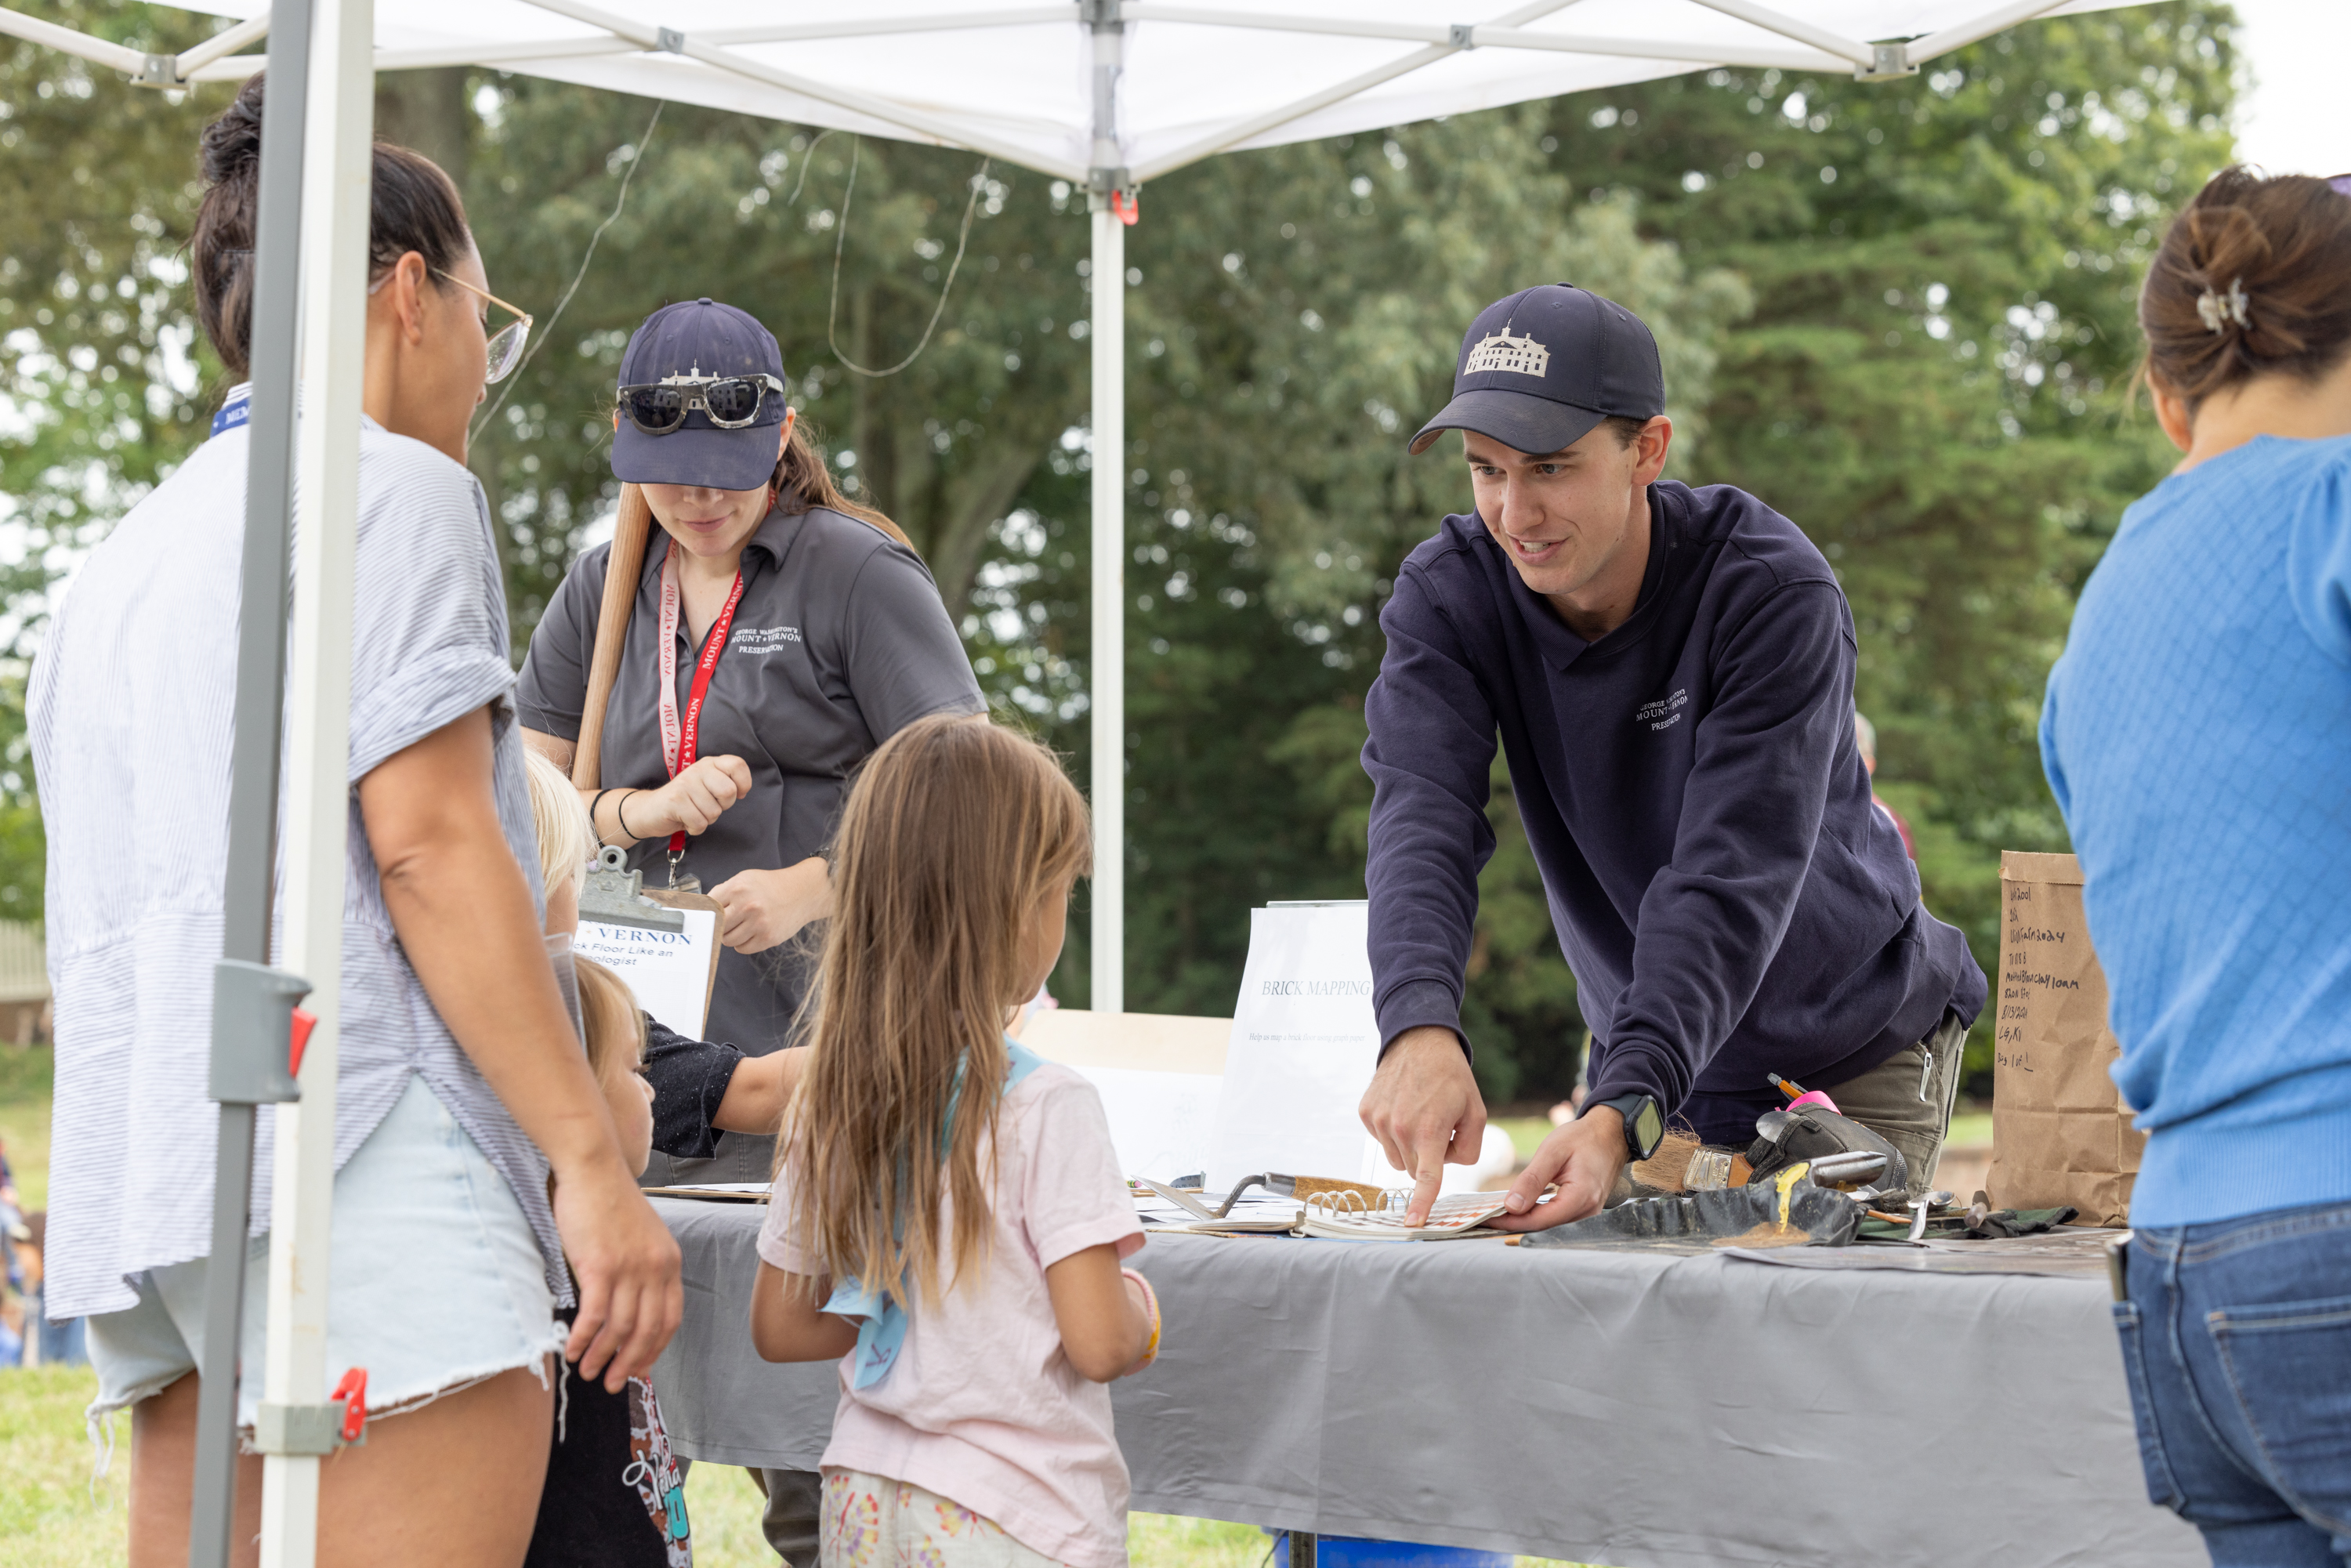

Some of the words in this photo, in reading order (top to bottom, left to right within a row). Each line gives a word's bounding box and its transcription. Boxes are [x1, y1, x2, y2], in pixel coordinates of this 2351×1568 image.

[730, 635, 762, 644] MOUNT
[767, 632, 801, 643] VERNON
[702, 626, 725, 669] MOUNT
[1636, 707, 1668, 722] MOUNT
[684, 697, 700, 749] VERNON
[599, 928, 693, 946] VERNON
[592, 943, 625, 954] Floor
[629, 946, 654, 956] Like
[1261, 980, 1305, 996] BRICK
[1306, 980, 1371, 996] MAPPING
[1249, 1033, 1262, 1042] Help
[1288, 1033, 1302, 1041] brick
[1302, 1033, 1317, 1041] floor
[1317, 1034, 1332, 1043] using
[1333, 1034, 1349, 1043] graph
[1349, 1034, 1365, 1043] paper
